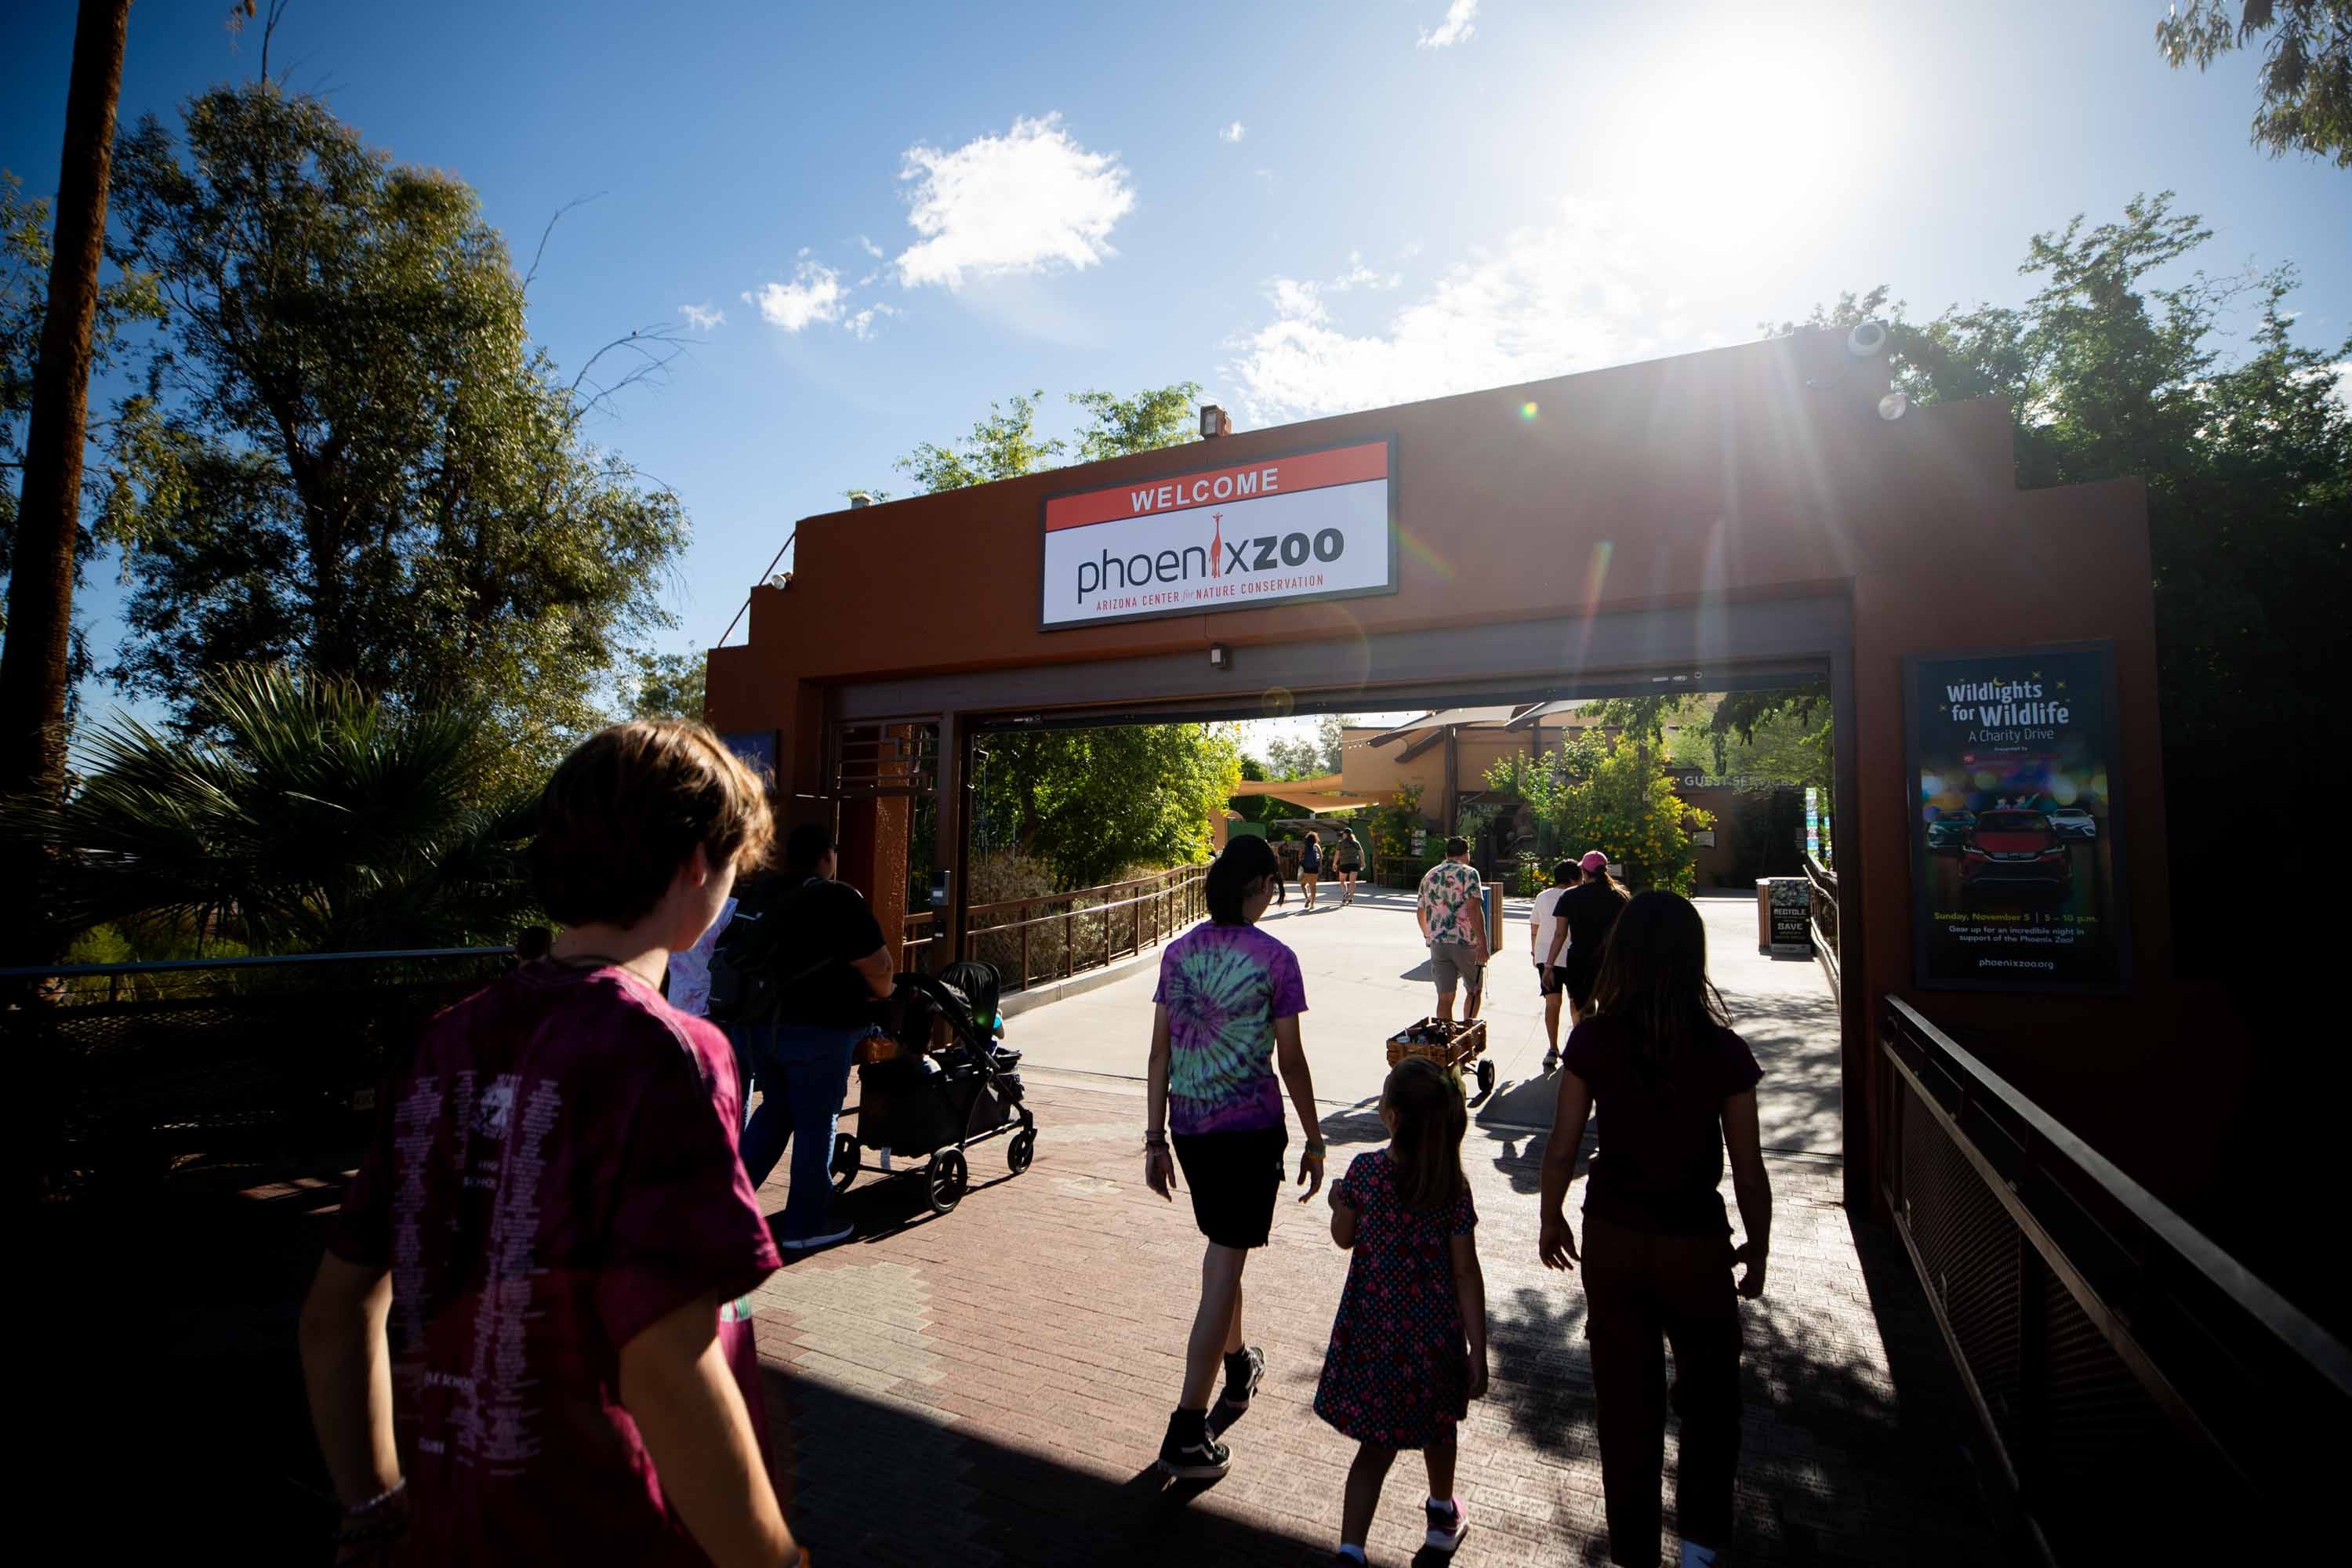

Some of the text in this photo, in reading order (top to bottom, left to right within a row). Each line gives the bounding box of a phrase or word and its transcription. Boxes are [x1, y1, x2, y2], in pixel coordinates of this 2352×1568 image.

[1131, 468, 1279, 512] WELCOME
[1096, 574, 1324, 612] ARIZONA CENTER for NATURE CONSERVATION
[1946, 680, 2043, 704] Wildlights
[1951, 700, 2070, 728] for Wildlife
[1969, 728, 2054, 744] A Charity Drive
[1934, 912, 1969, 922] Sunday,
[1972, 913, 2020, 922] November
[1983, 925, 1995, 934] for
[2009, 926, 2050, 935] incredible
[2053, 927, 2075, 936] night
[1978, 959, 2055, 971] phoenixzoo.org
